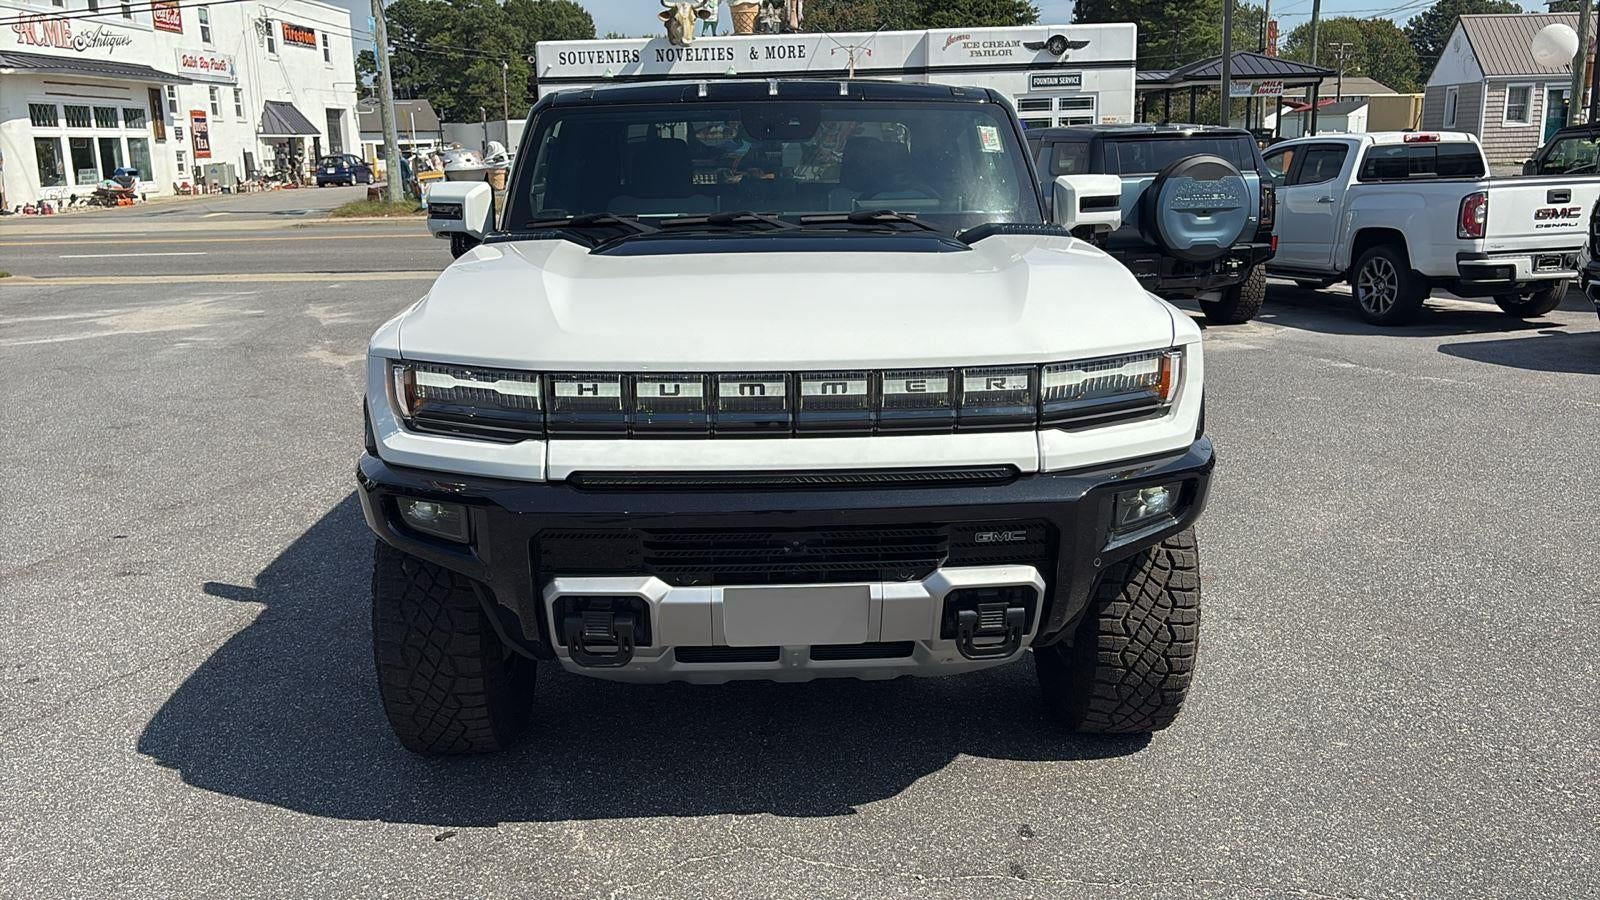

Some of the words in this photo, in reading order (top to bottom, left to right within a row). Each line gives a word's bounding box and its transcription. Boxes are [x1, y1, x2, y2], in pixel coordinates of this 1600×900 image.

[12, 11, 73, 50] ACME
[962, 41, 980, 49] ICE
[982, 40, 1021, 48] CREAM
[558, 49, 640, 66] SOUVENIRS
[656, 47, 734, 63] NOVELTIES
[749, 46, 759, 60] &
[765, 45, 806, 60] MORE
[969, 49, 1013, 57] PARLOR
[182, 54, 197, 68] Dutch
[199, 56, 209, 72] Boy
[210, 57, 227, 71] Paints
[1033, 77, 1058, 85] FOUNTAIN
[1059, 76, 1080, 84] SERVICE
[1534, 207, 1581, 220] GMC
[975, 531, 1026, 542] GMC
